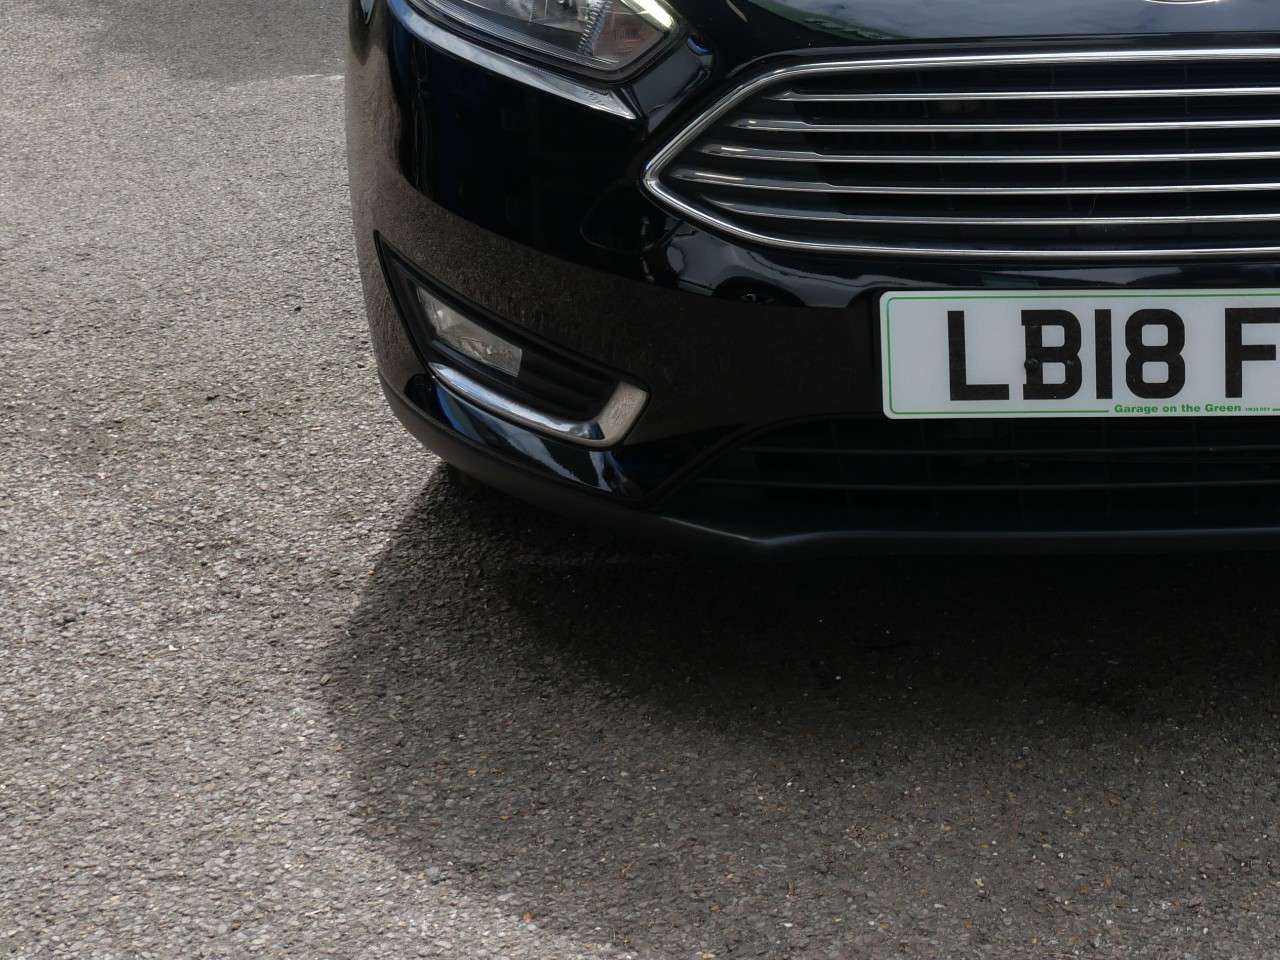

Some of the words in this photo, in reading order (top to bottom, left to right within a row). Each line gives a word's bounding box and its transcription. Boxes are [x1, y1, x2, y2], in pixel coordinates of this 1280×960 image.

[947, 308, 1186, 400] LB18
[1114, 404, 1158, 414] Garage
[1162, 404, 1177, 413] on
[1181, 403, 1201, 413] the
[1204, 403, 1241, 413] Green
